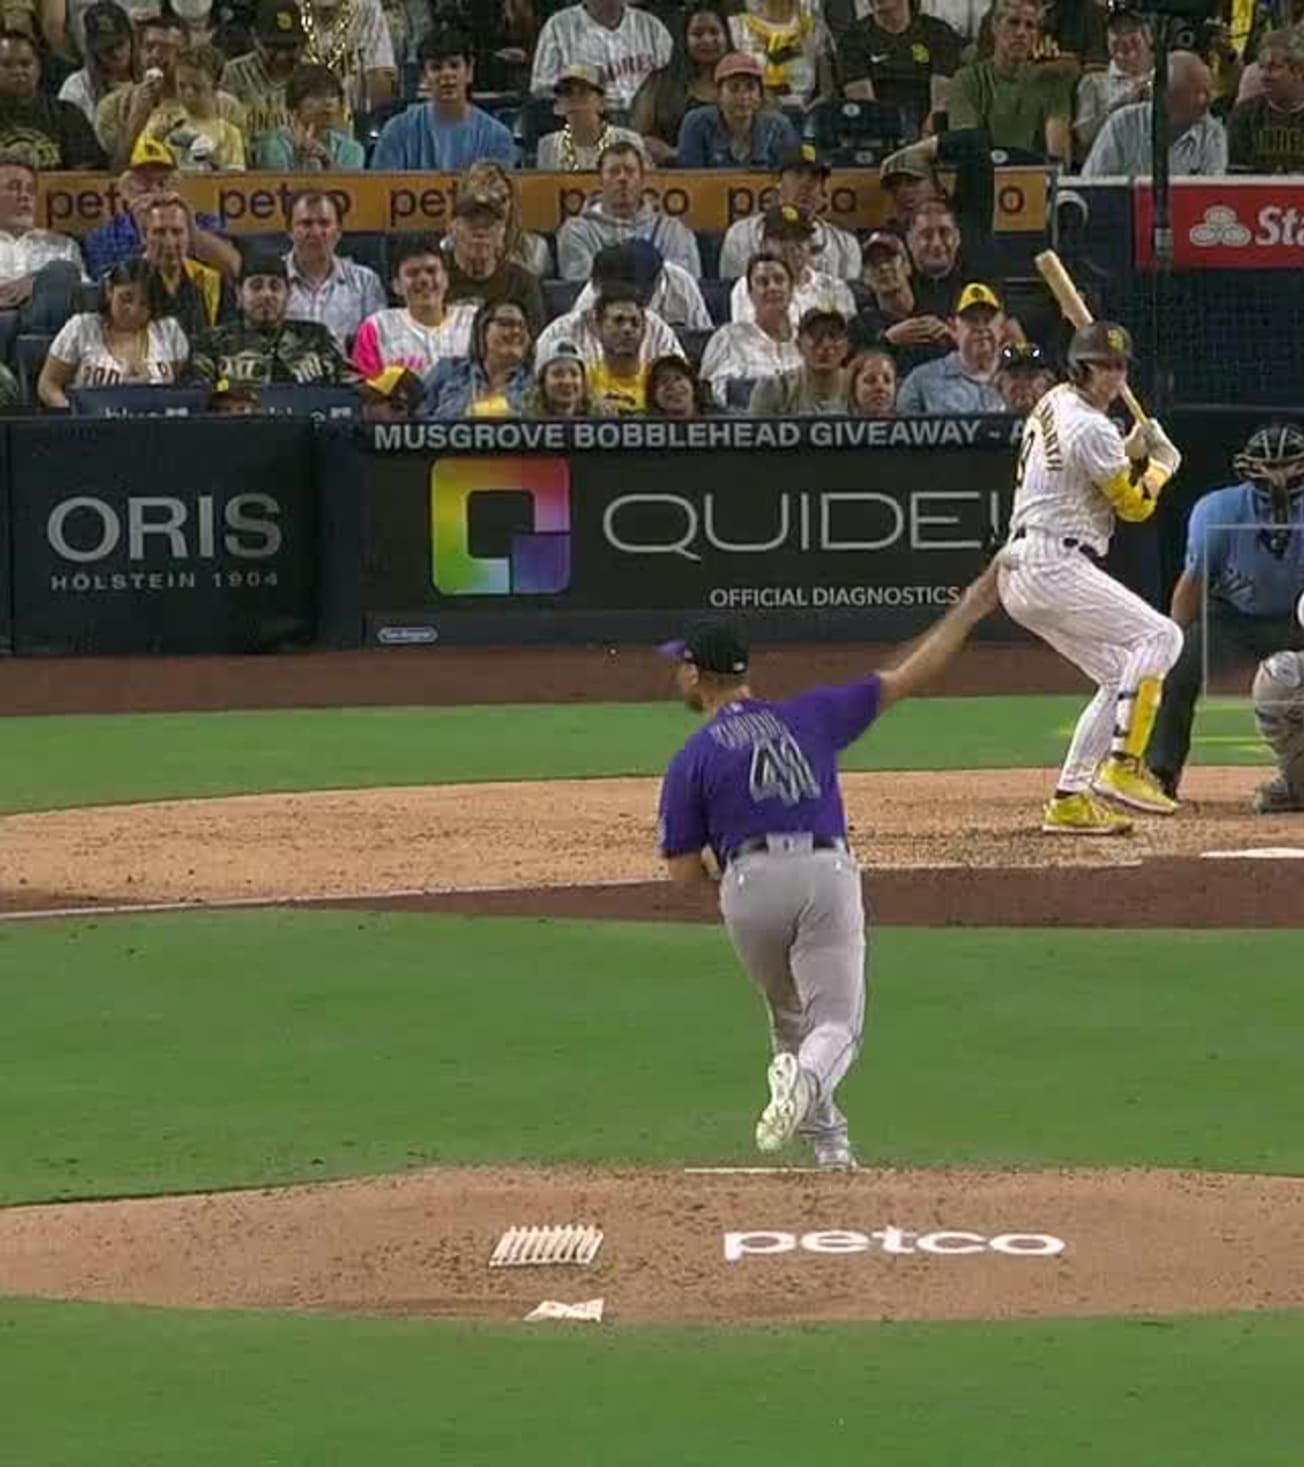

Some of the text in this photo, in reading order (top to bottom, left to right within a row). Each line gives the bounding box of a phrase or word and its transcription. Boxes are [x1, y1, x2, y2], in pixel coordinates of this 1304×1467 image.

[374, 424, 564, 448] MUSGROVE
[573, 422, 800, 448] BOBBLEHEAD
[809, 420, 981, 446] GIVEAWAY
[47, 492, 283, 562] ORIS
[211, 570, 279, 588] 1904
[709, 586, 961, 609] OFFICIAL DIAGNOSTICS
[723, 1225, 1066, 1262] petco
